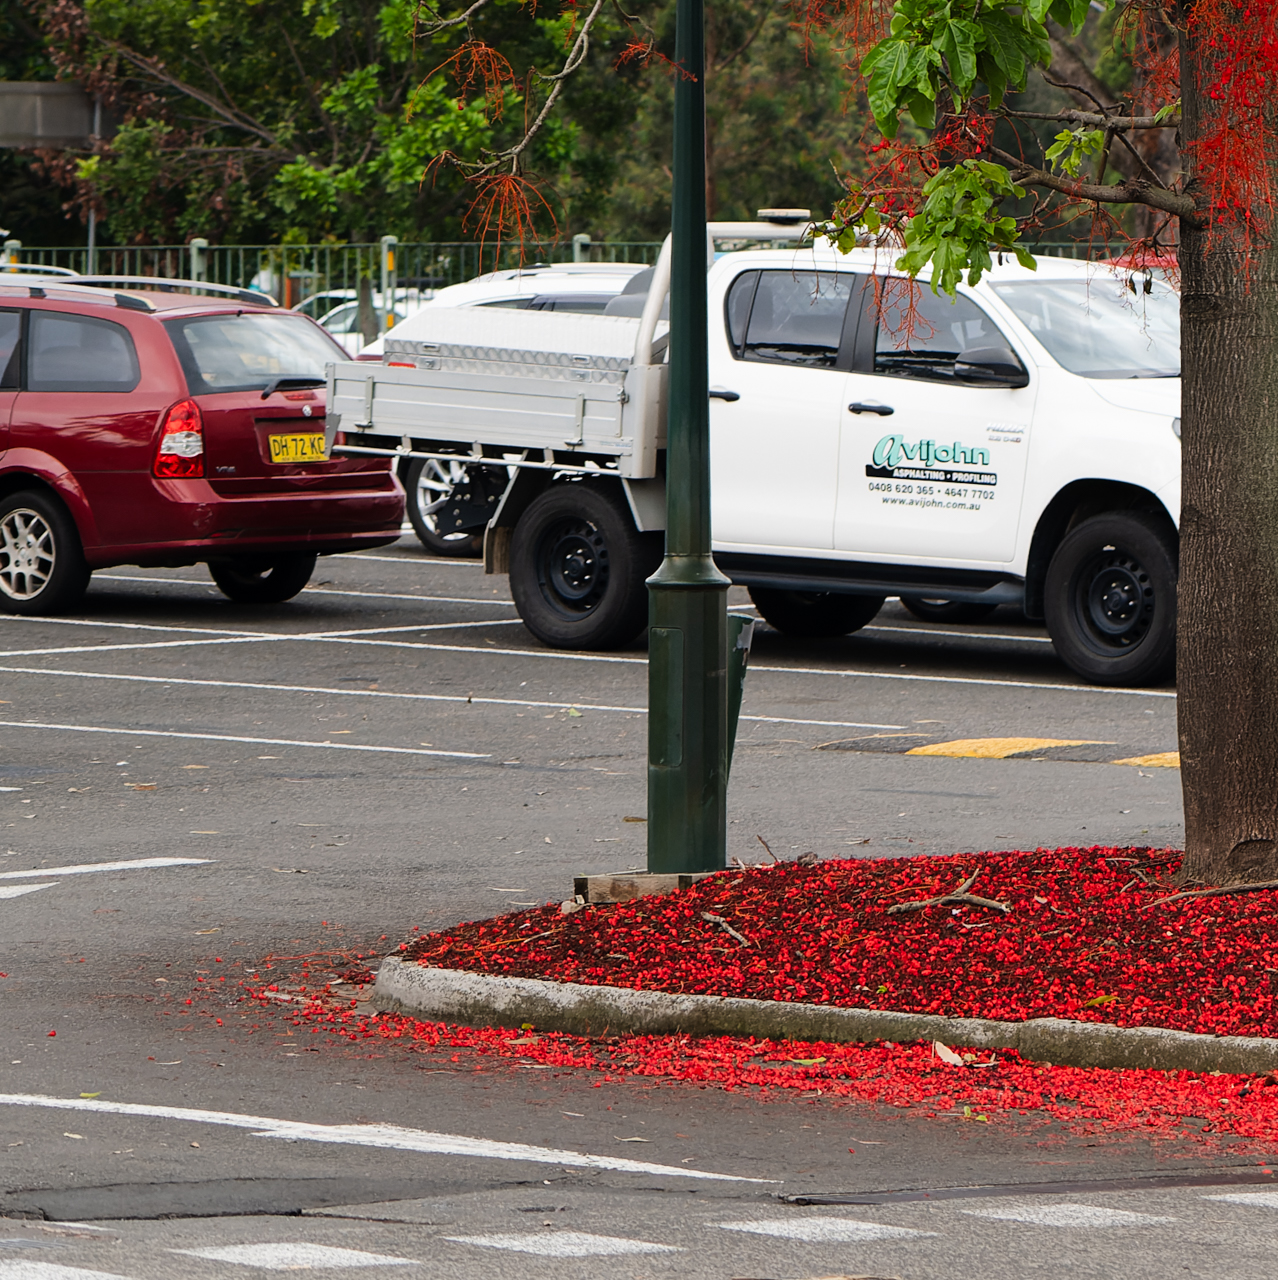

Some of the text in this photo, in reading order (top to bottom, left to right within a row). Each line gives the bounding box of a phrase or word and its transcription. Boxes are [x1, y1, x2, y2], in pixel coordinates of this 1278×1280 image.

[873, 434, 990, 467] avijohn
[893, 468, 996, 484] ASPHALTING PROFILING
[868, 482, 995, 500] 0408 620 365 4647 7702
[882, 496, 981, 511] www.avijohn.com.au
